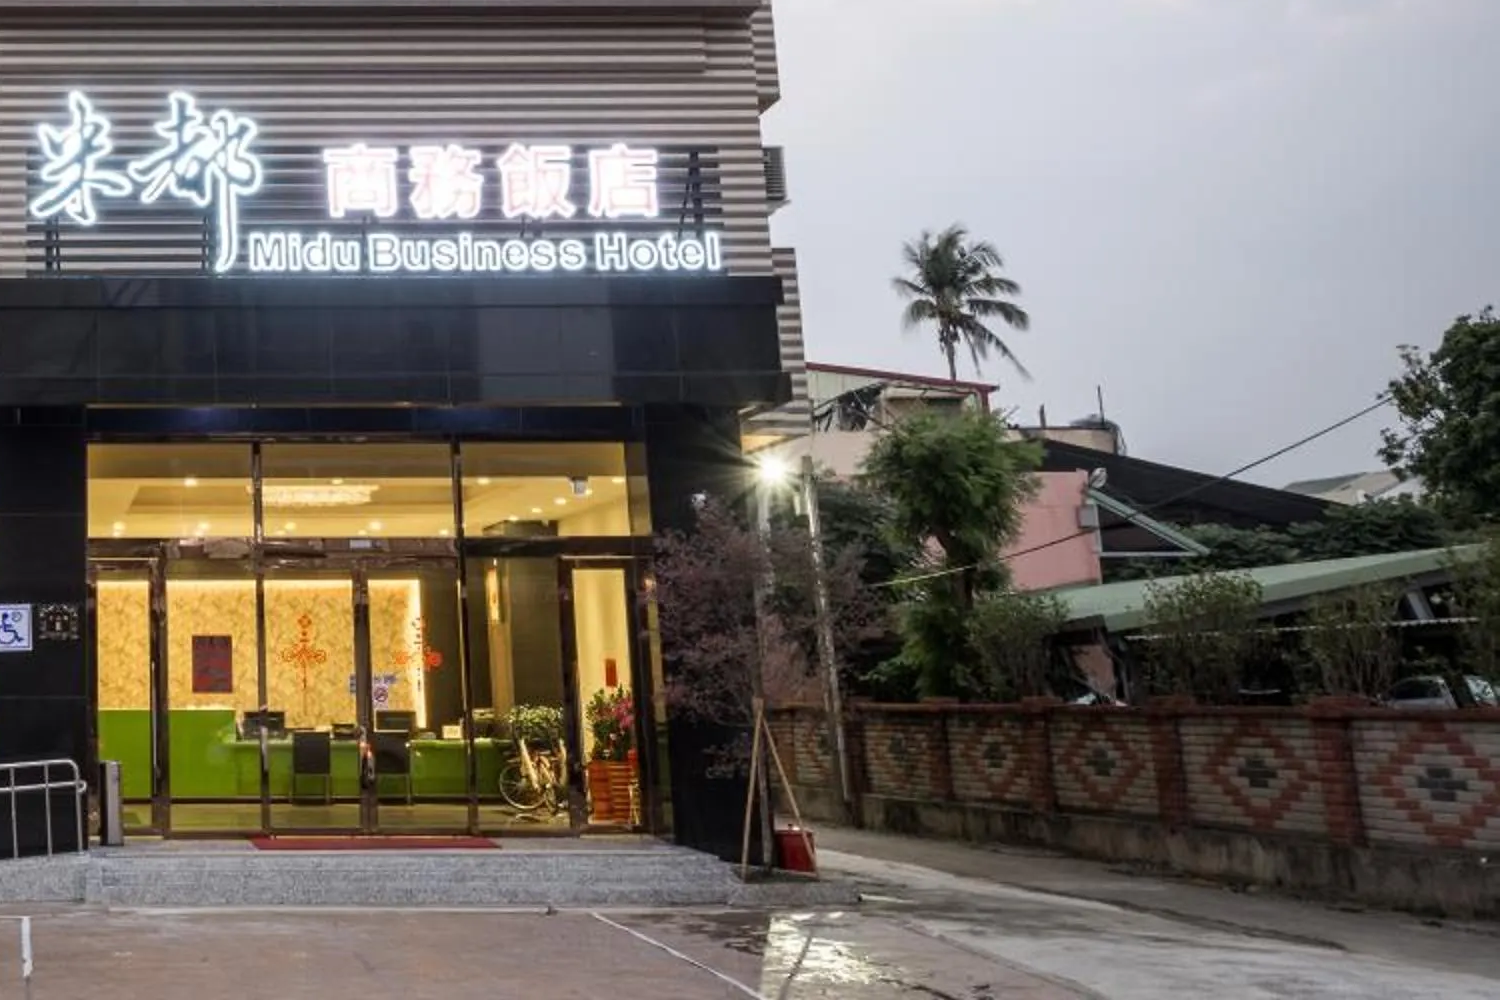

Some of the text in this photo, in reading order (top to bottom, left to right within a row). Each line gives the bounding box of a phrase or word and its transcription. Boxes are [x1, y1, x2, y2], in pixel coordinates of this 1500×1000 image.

[323, 143, 659, 218] 商務飯店
[249, 231, 720, 270] Midu Business Hotel
